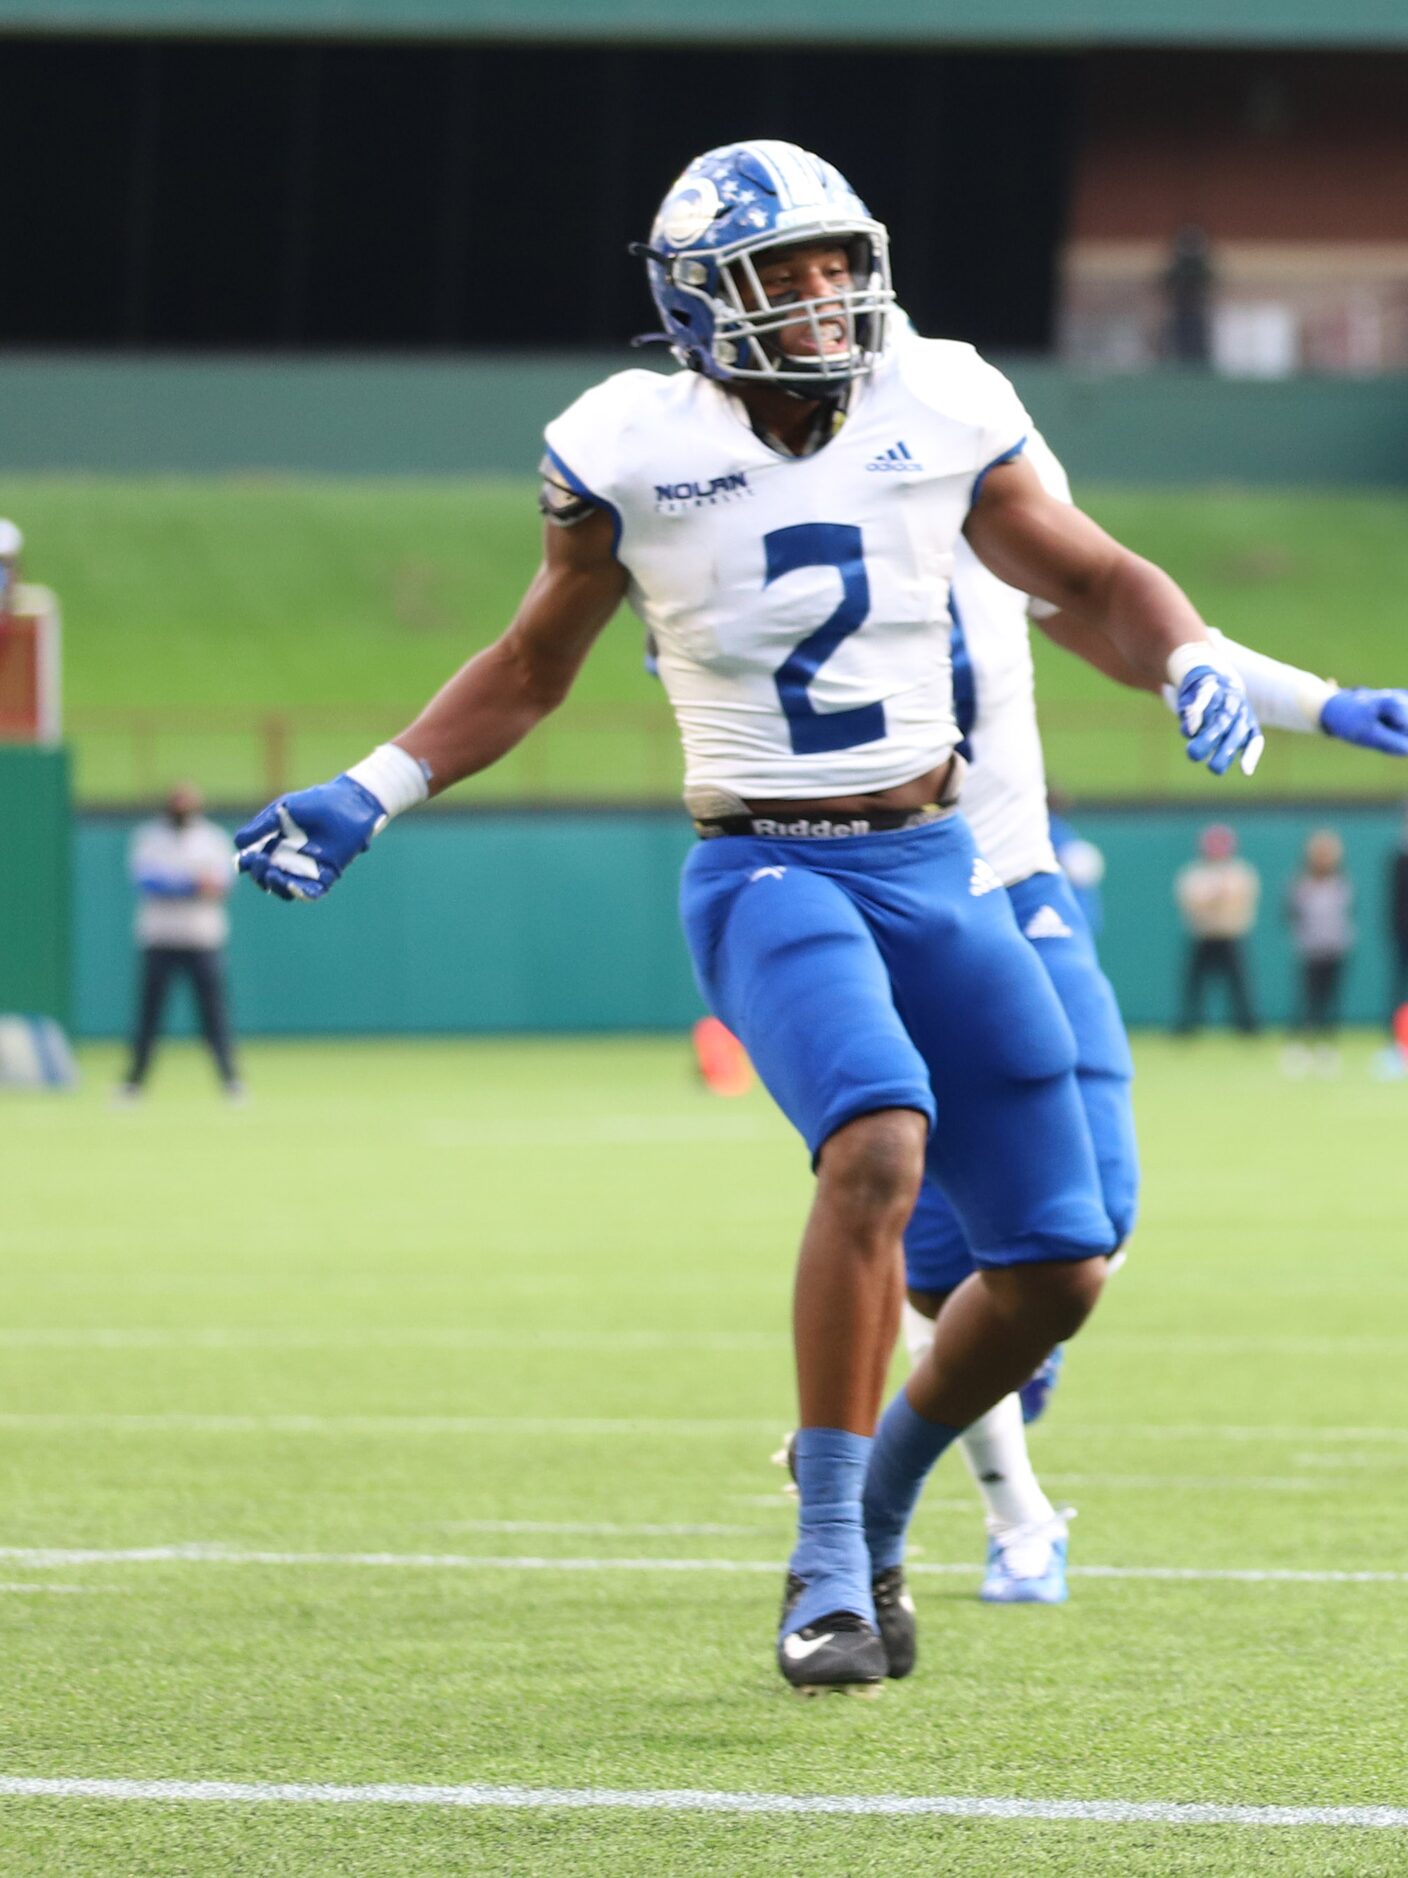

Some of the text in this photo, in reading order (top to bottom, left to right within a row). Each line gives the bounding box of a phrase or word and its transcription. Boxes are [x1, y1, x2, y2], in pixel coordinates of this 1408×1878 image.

[654, 471, 748, 502] NOLAN
[763, 522, 888, 756] 2
[751, 819, 871, 838] Riddell
